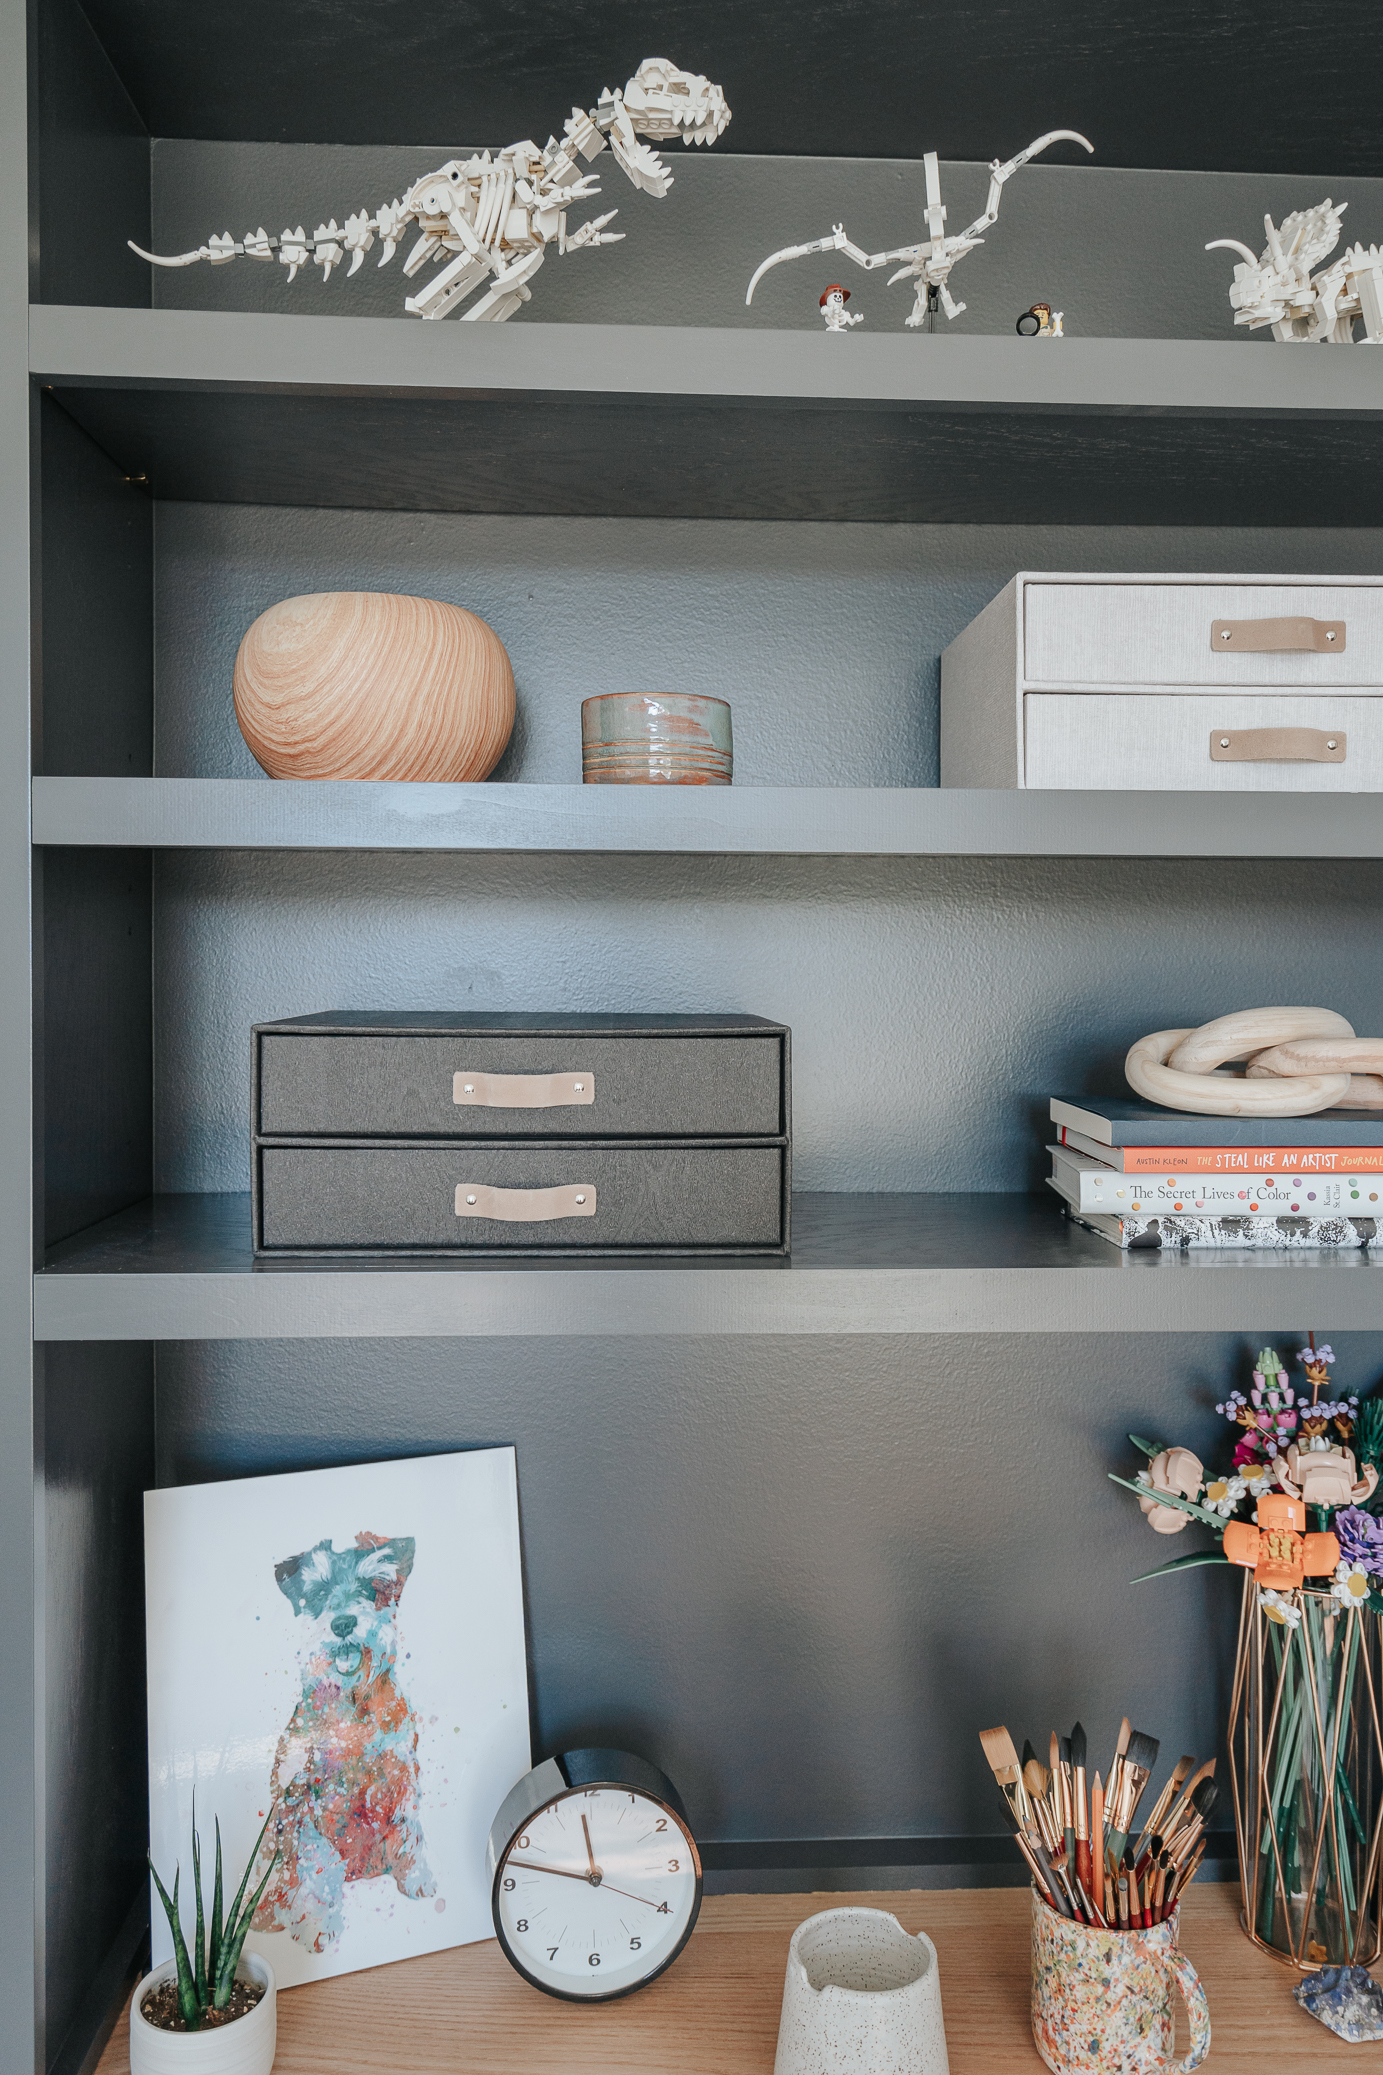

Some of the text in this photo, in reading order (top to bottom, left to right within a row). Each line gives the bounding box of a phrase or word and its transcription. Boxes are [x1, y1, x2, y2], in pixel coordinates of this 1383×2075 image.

[1136, 1157, 1188, 1166] AUSTIN KLEON
[1197, 1152, 1383, 1170] THE STEAL LIKE AN ARTIST JOURNAL
[1129, 1185, 1153, 1199] The
[1157, 1185, 1196, 1199] Secret
[1201, 1186, 1235, 1199] Lives
[1256, 1186, 1292, 1200] Color
[1323, 1185, 1331, 1206] Kassia
[655, 1818, 668, 1832] 2
[668, 1859, 680, 1873] 3
[503, 1878, 516, 1892] 9
[656, 1901, 668, 1914] 4
[516, 1919, 529, 1932] 8
[629, 1937, 642, 1950] 5
[546, 1947, 559, 1960] 7
[588, 1953, 601, 1967] 6
